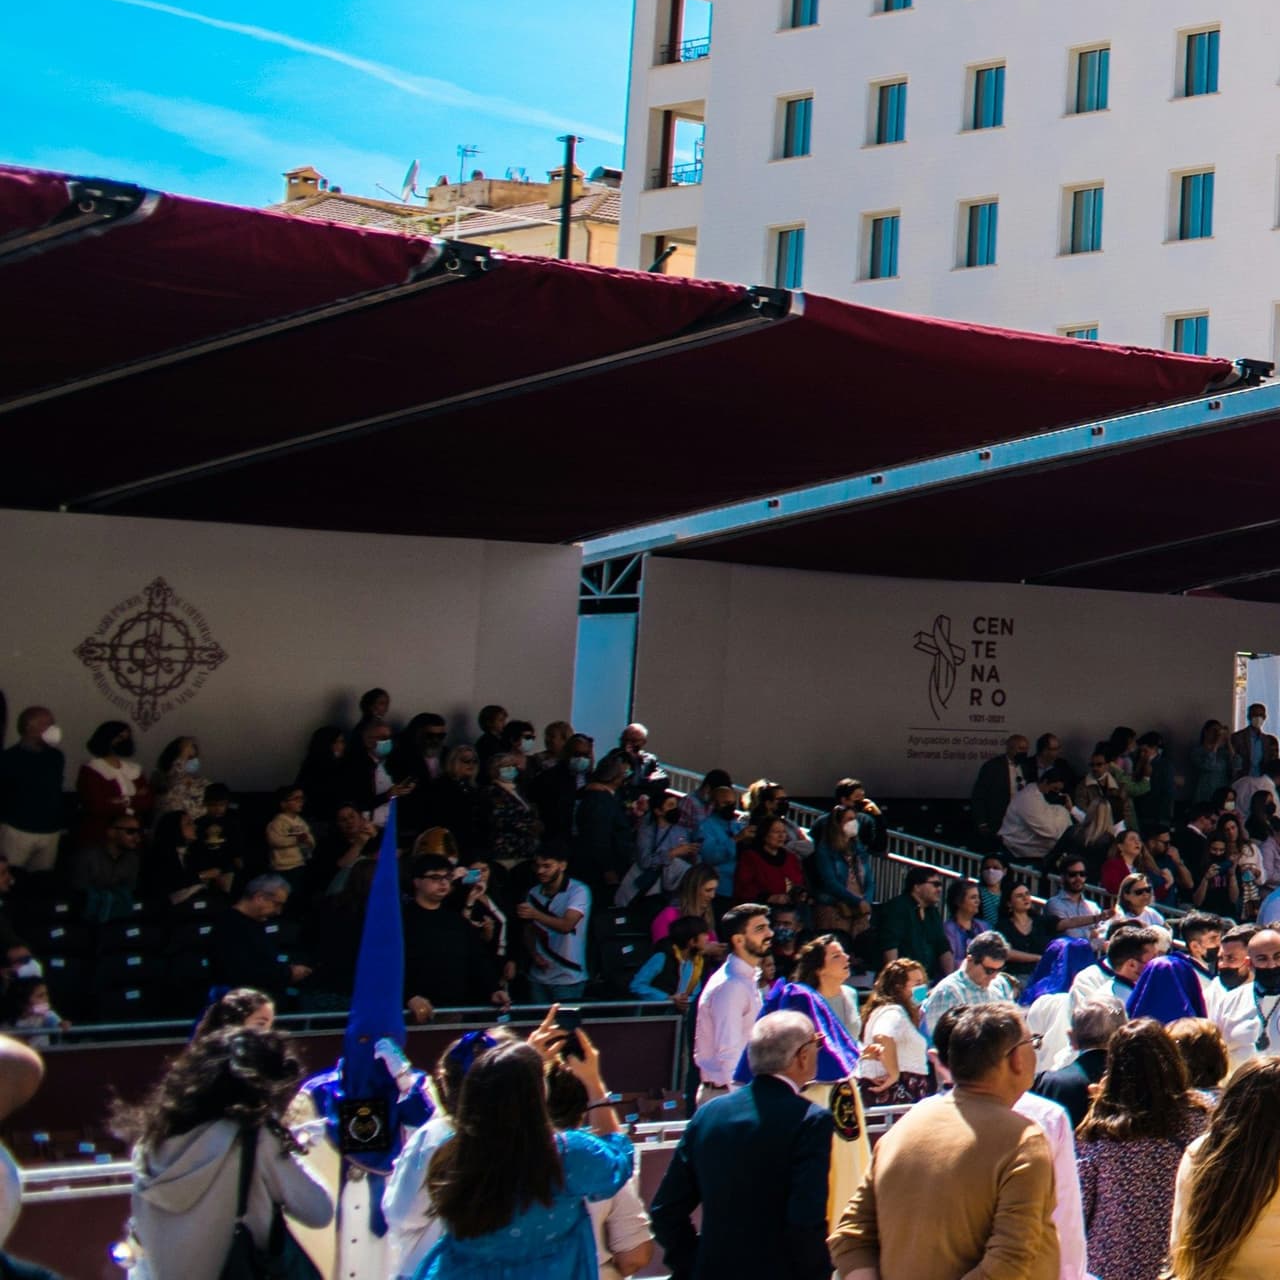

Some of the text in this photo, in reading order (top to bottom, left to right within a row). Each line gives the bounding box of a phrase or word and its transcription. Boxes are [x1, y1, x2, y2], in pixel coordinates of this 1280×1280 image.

[973, 616, 1014, 636] CEN
[971, 640, 997, 658] TE
[970, 664, 1000, 683] NA
